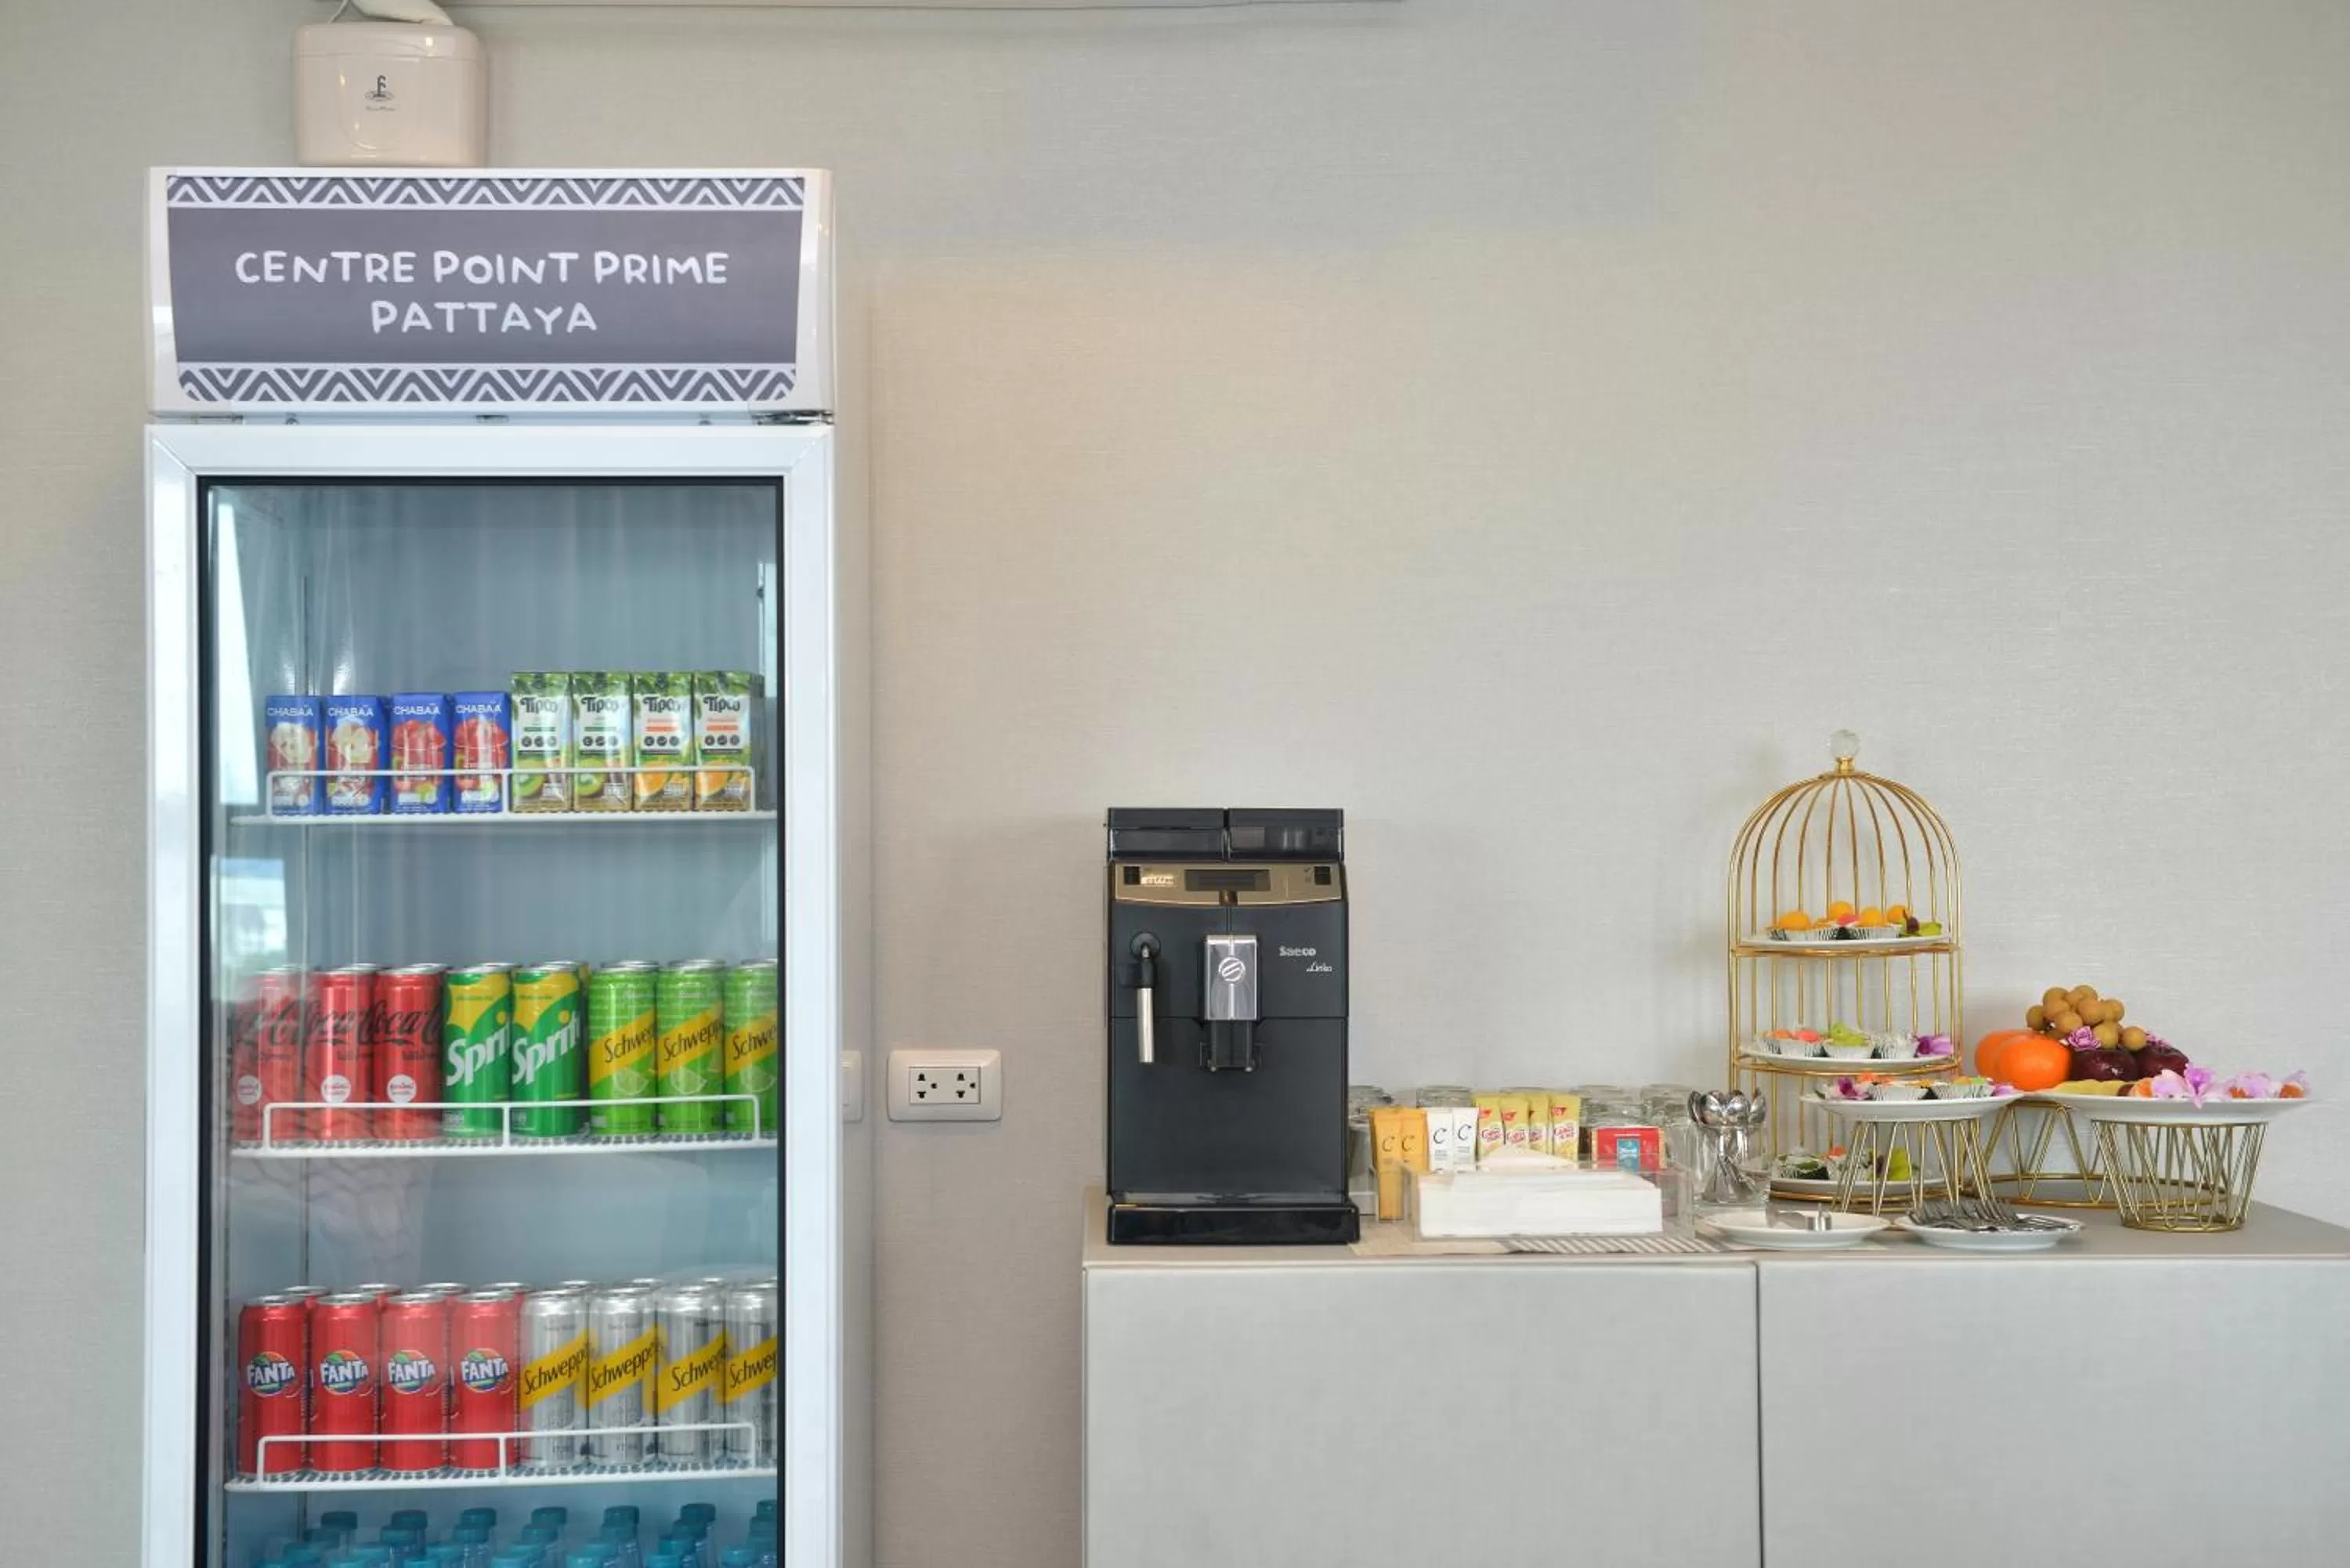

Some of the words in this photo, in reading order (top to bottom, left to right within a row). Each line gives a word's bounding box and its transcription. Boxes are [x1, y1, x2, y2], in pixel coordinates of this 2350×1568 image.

[235, 251, 417, 284] CENTRE
[432, 251, 580, 285] POINT
[594, 251, 730, 284] PRIME
[371, 302, 598, 335] PATTAYA
[267, 706, 314, 717] CHABAA
[328, 706, 374, 717] CHABAA
[393, 705, 440, 715] CHABAA
[455, 703, 501, 714] CHABAA
[642, 696, 681, 714] Tipco
[703, 695, 740, 714] Tipco
[1278, 945, 1317, 956] Saeco
[246, 1360, 295, 1384] FANTA
[320, 1359, 369, 1383] FANTA
[387, 1358, 436, 1382] FANTA
[460, 1357, 508, 1381] FANTA
